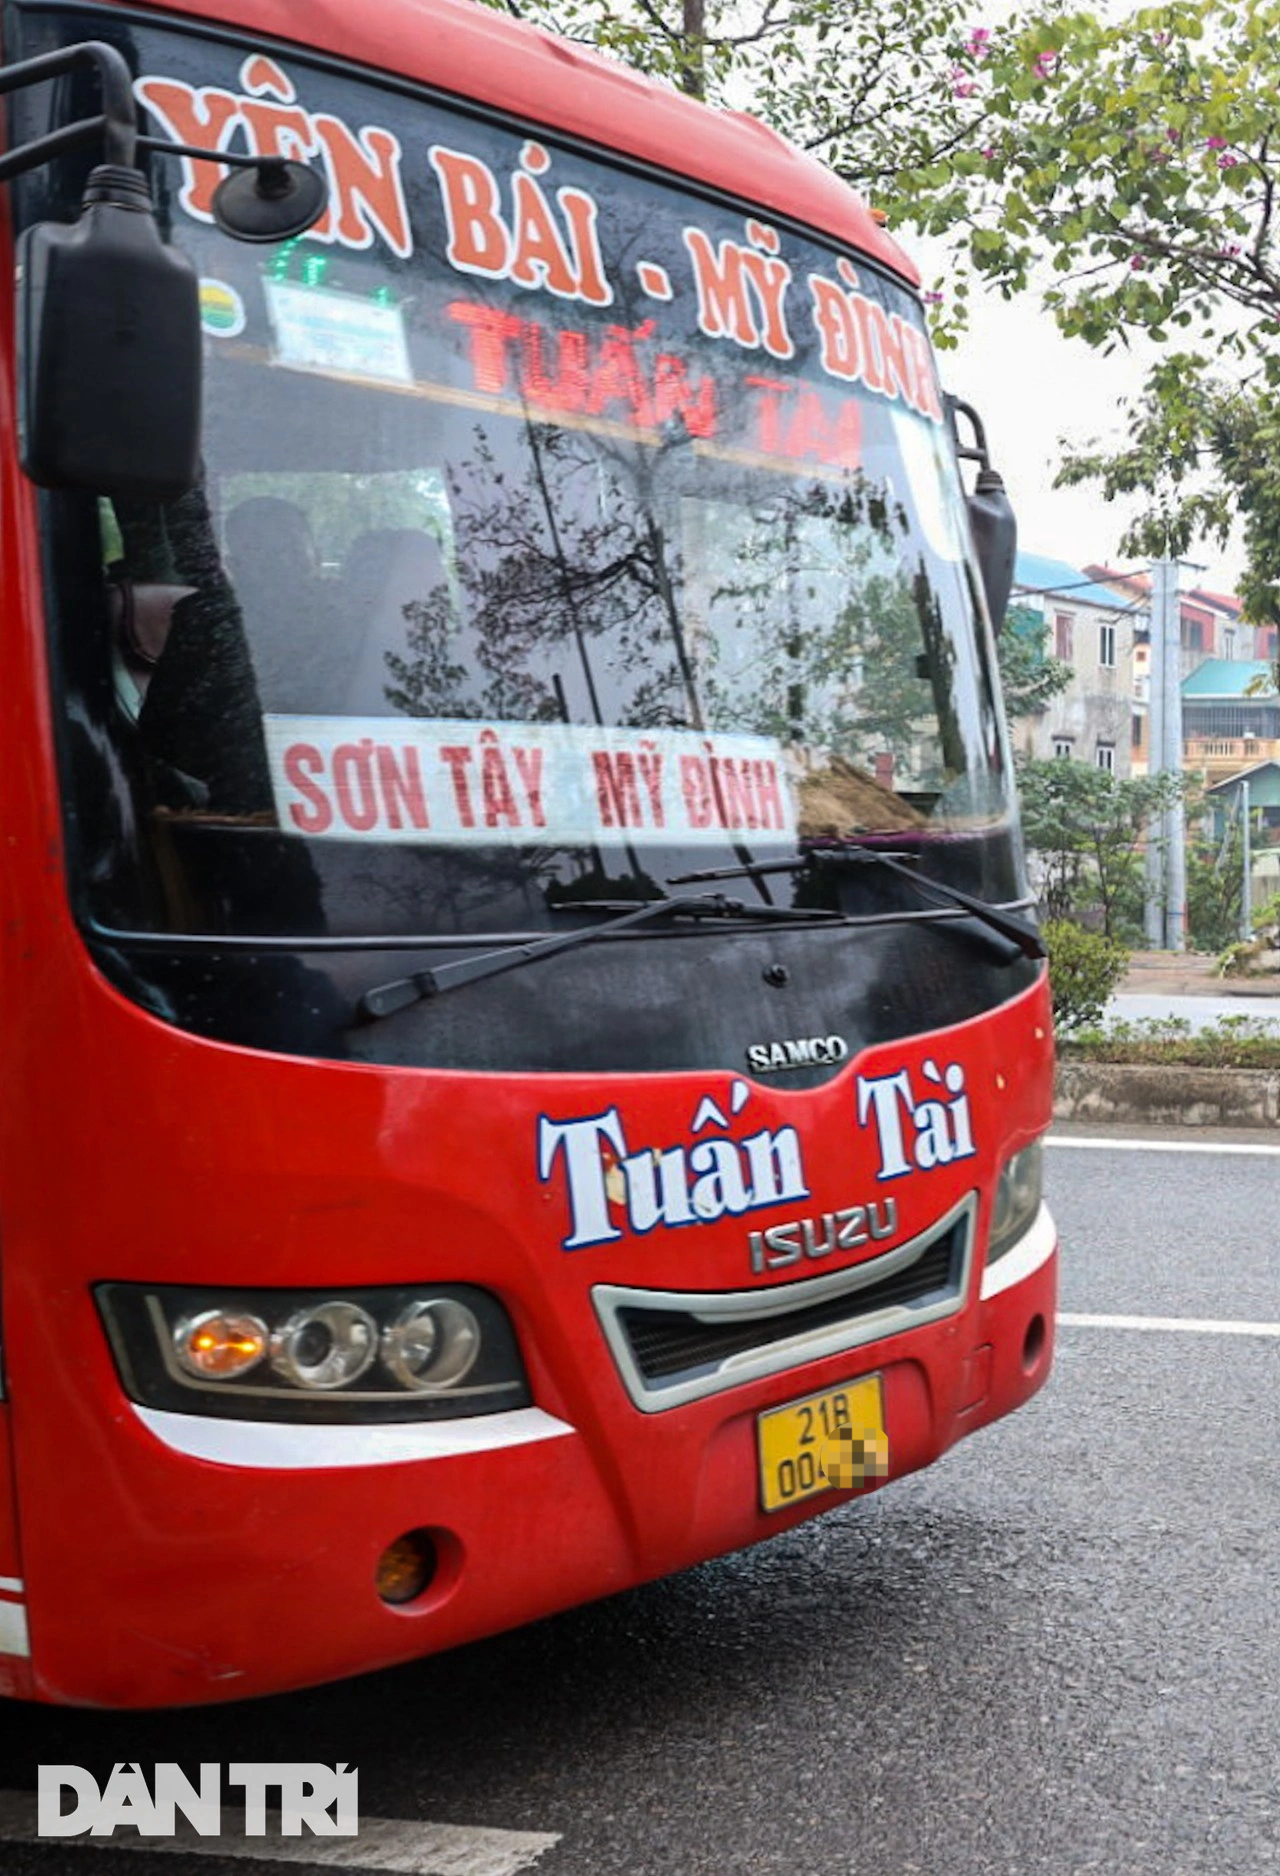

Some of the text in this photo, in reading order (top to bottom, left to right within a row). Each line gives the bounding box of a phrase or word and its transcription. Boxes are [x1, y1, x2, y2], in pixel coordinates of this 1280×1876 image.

[683, 217, 795, 360] MỸ
[808, 256, 944, 424] ĐÌNH
[283, 727, 785, 833] SƠN TÂY MỸ ĐÌNH
[747, 1034, 848, 1073] SAMCO
[536, 1059, 976, 1251] Tuấn Tài
[748, 1197, 898, 1274] ISUZU
